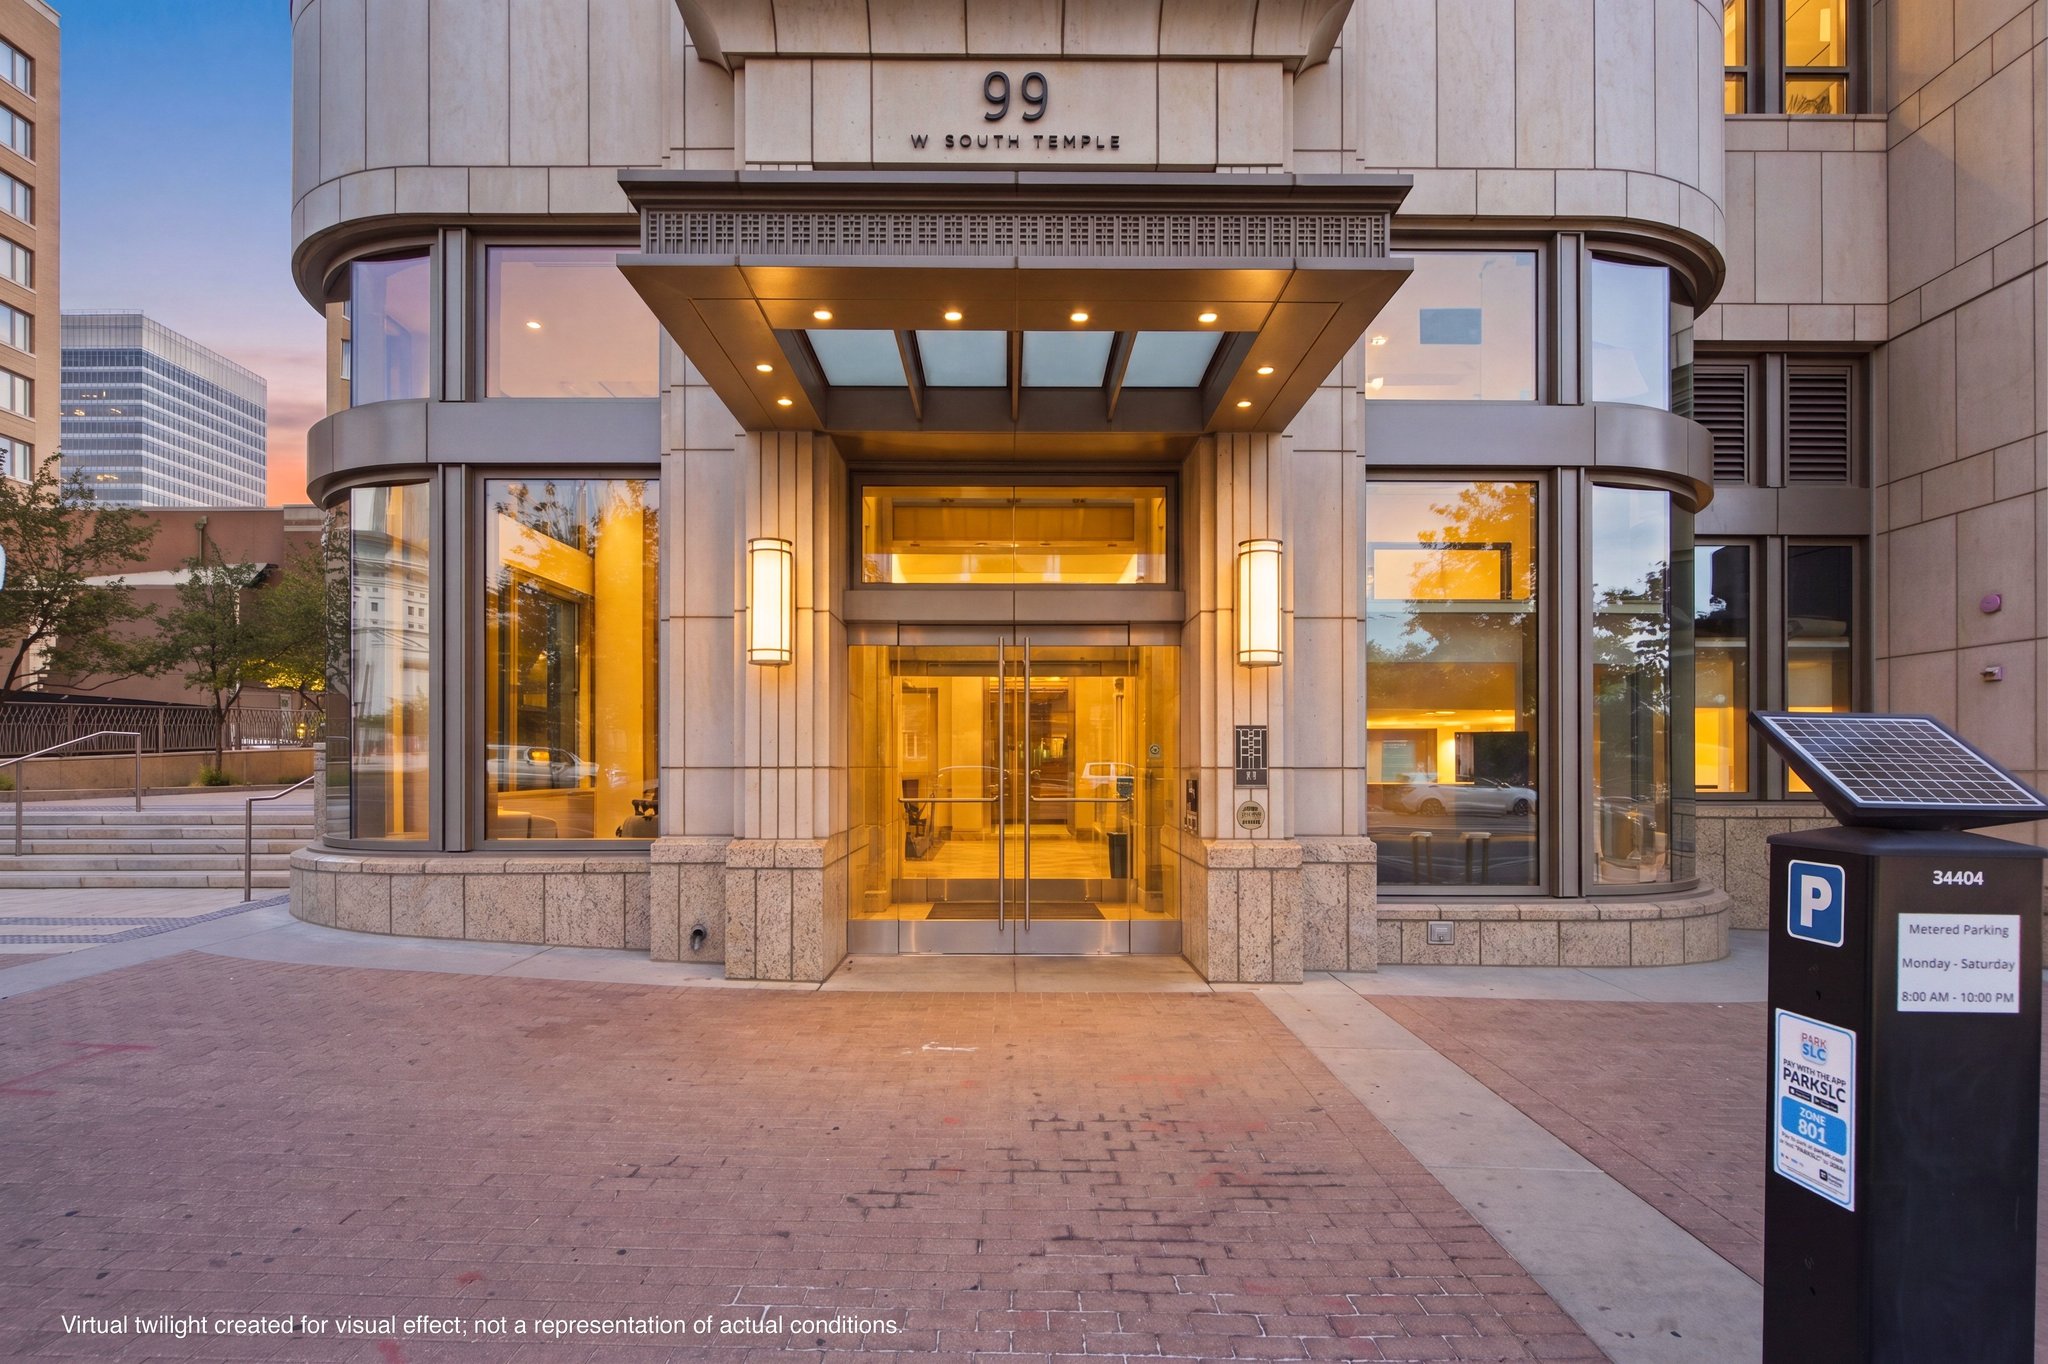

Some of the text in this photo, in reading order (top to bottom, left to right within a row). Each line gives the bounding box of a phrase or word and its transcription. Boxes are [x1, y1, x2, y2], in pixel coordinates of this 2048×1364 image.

[983, 70, 1048, 122] 99
[910, 133, 1121, 150] W SOUTH TEMPLE
[1932, 869, 1985, 886] 34404
[1799, 873, 1834, 929] P
[1908, 923, 2010, 939] Metered Parking
[1901, 957, 1951, 972] Monday
[1960, 958, 2016, 973] Saturday
[1901, 990, 1927, 1003] 8:00
[1929, 991, 1950, 1003] AM
[1960, 991, 1993, 1004] 10:00
[1995, 992, 2015, 1003] PM
[1801, 1031, 1828, 1050] PARK
[1801, 1042, 1828, 1062] SLC
[1782, 1057, 1848, 1088] PAY WITH THE APP
[1782, 1066, 1847, 1104] PARKSLC
[1799, 1106, 1827, 1127] ZONE
[1797, 1118, 1828, 1145] 801
